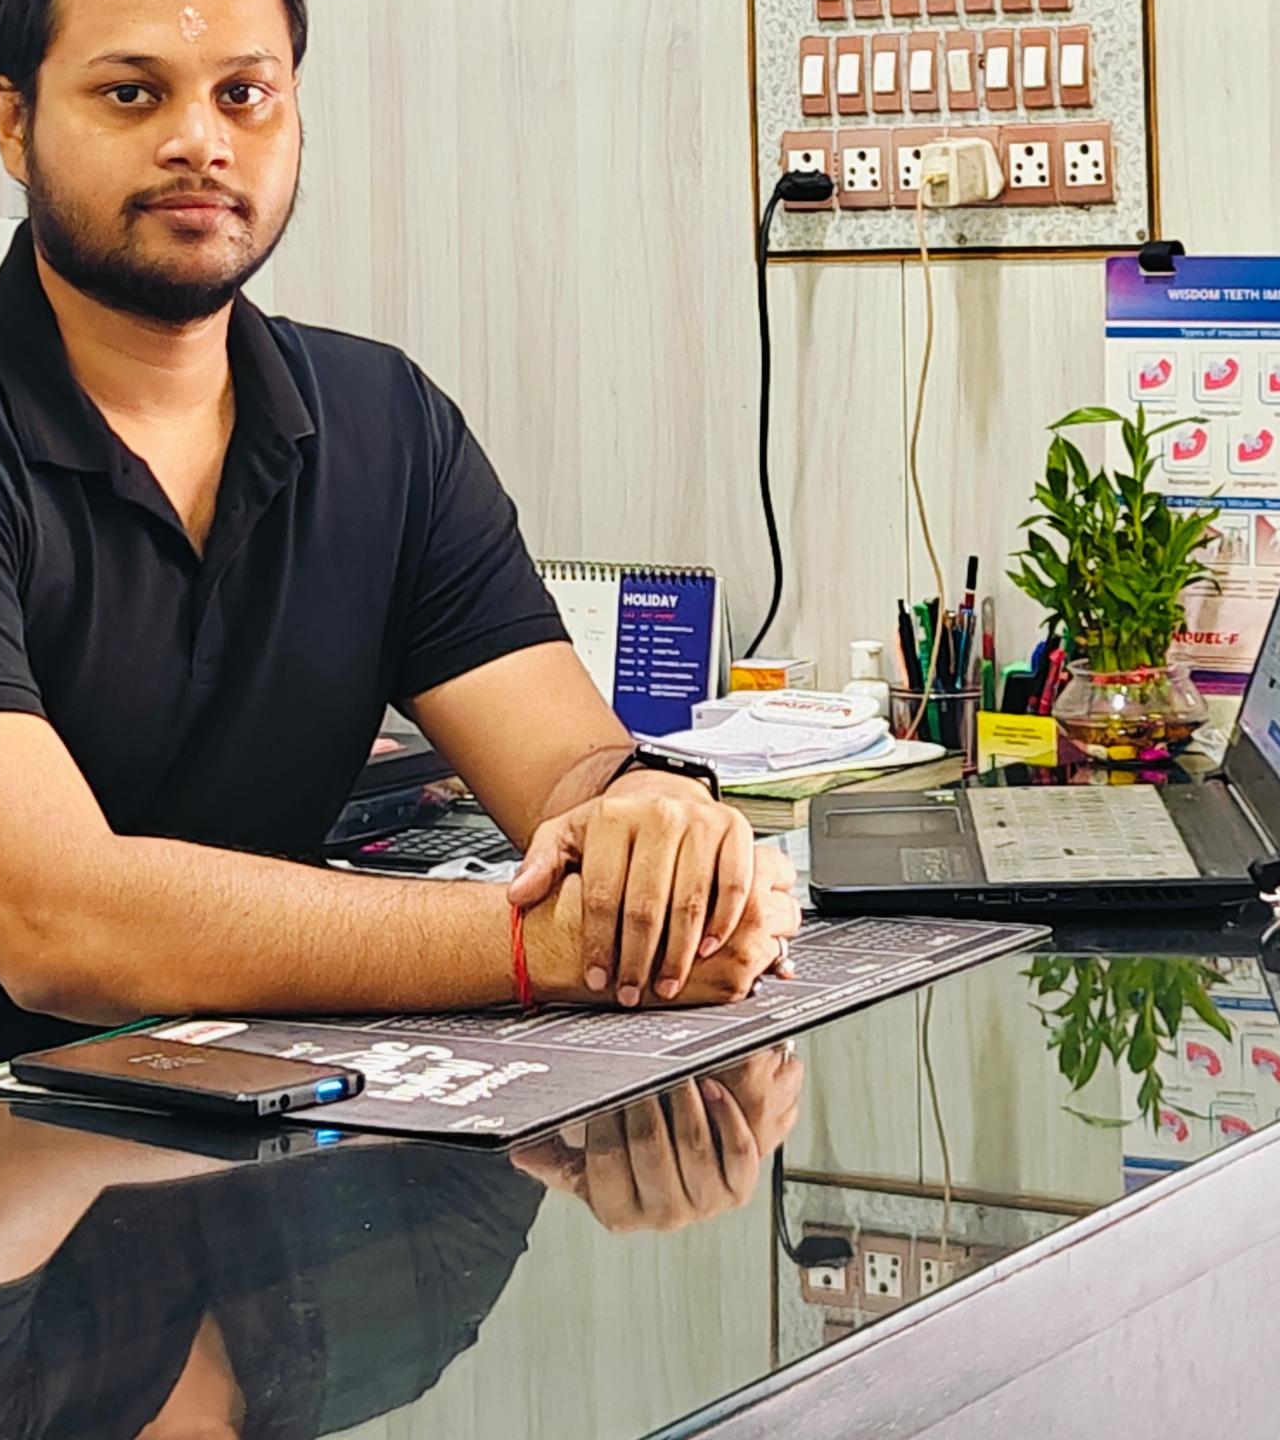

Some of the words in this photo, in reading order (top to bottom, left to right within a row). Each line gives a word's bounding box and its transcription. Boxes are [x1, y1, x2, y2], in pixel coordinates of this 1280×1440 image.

[1168, 288, 1220, 301] WISDOM
[1223, 288, 1260, 301] TEETH
[1180, 329, 1205, 339] Types
[623, 593, 678, 608] HOLIDAY
